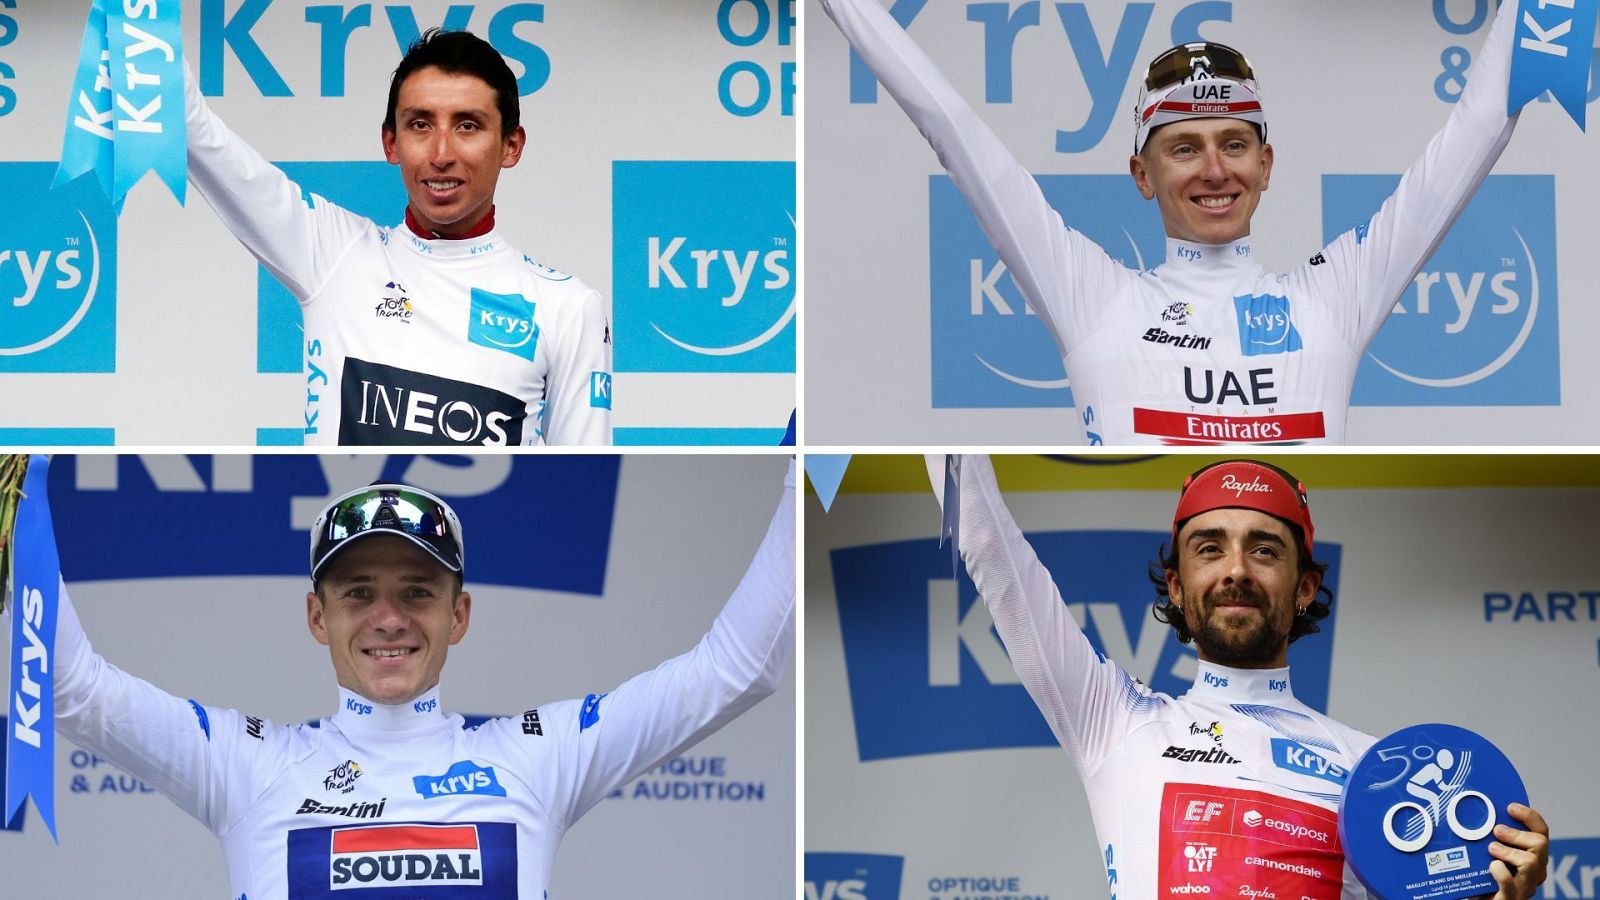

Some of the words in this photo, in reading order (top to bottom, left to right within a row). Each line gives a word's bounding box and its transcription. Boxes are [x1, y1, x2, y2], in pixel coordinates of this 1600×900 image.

[1192, 85, 1231, 99] UAE
[1191, 103, 1229, 113] Emirates
[1177, 247, 1201, 261] Krys
[648, 237, 790, 306] Krys
[481, 310, 529, 333] Krys
[1142, 328, 1212, 349] Santini
[305, 339, 328, 435] Krys
[1184, 366, 1277, 405] UAE
[357, 380, 513, 446] INEOS
[1186, 417, 1282, 438] Emirates
[14, 584, 48, 749] Krys
[1204, 672, 1229, 687] Krys
[1269, 679, 1287, 692] Krys
[347, 699, 372, 715] Krys
[414, 698, 437, 714] Krys
[649, 757, 726, 775] IQUE
[1286, 745, 1345, 780] Krys
[431, 771, 490, 794] Krys
[633, 781, 765, 800] AUDITION
[296, 798, 386, 818] Santini
[1184, 800, 1225, 822] EF
[1264, 821, 1328, 843] easypost
[333, 854, 479, 883] SOUDAL
[1244, 856, 1322, 878] cannondale
[928, 877, 1020, 892] OPTIQUE
[1170, 882, 1211, 894] wahoo
